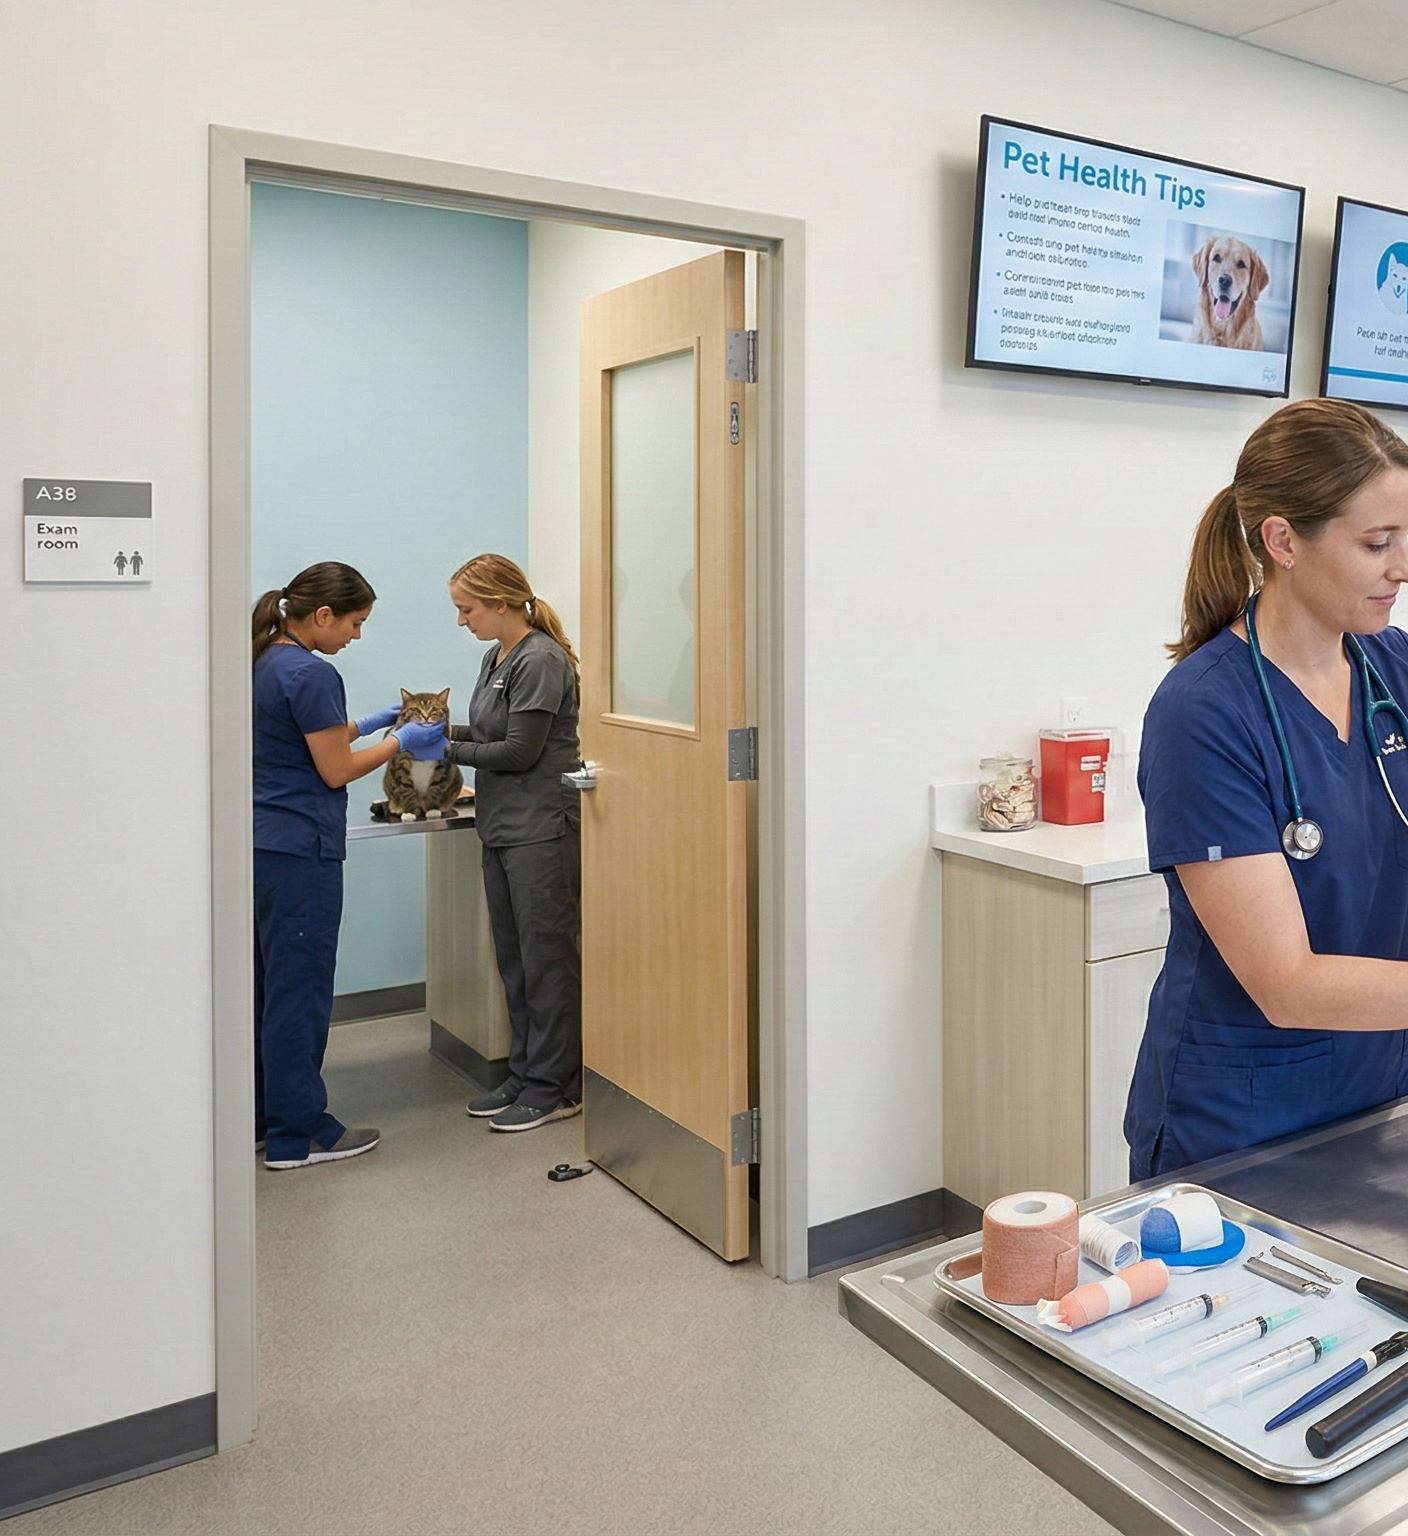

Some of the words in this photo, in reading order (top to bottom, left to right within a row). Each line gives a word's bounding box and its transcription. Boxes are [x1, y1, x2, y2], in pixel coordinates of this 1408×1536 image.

[1004, 141, 1050, 177] Pet
[1059, 153, 1147, 196] Health
[1154, 173, 1206, 210] Tips
[35, 486, 77, 501] A38
[37, 523, 78, 535] Exam
[37, 540, 79, 549] room
